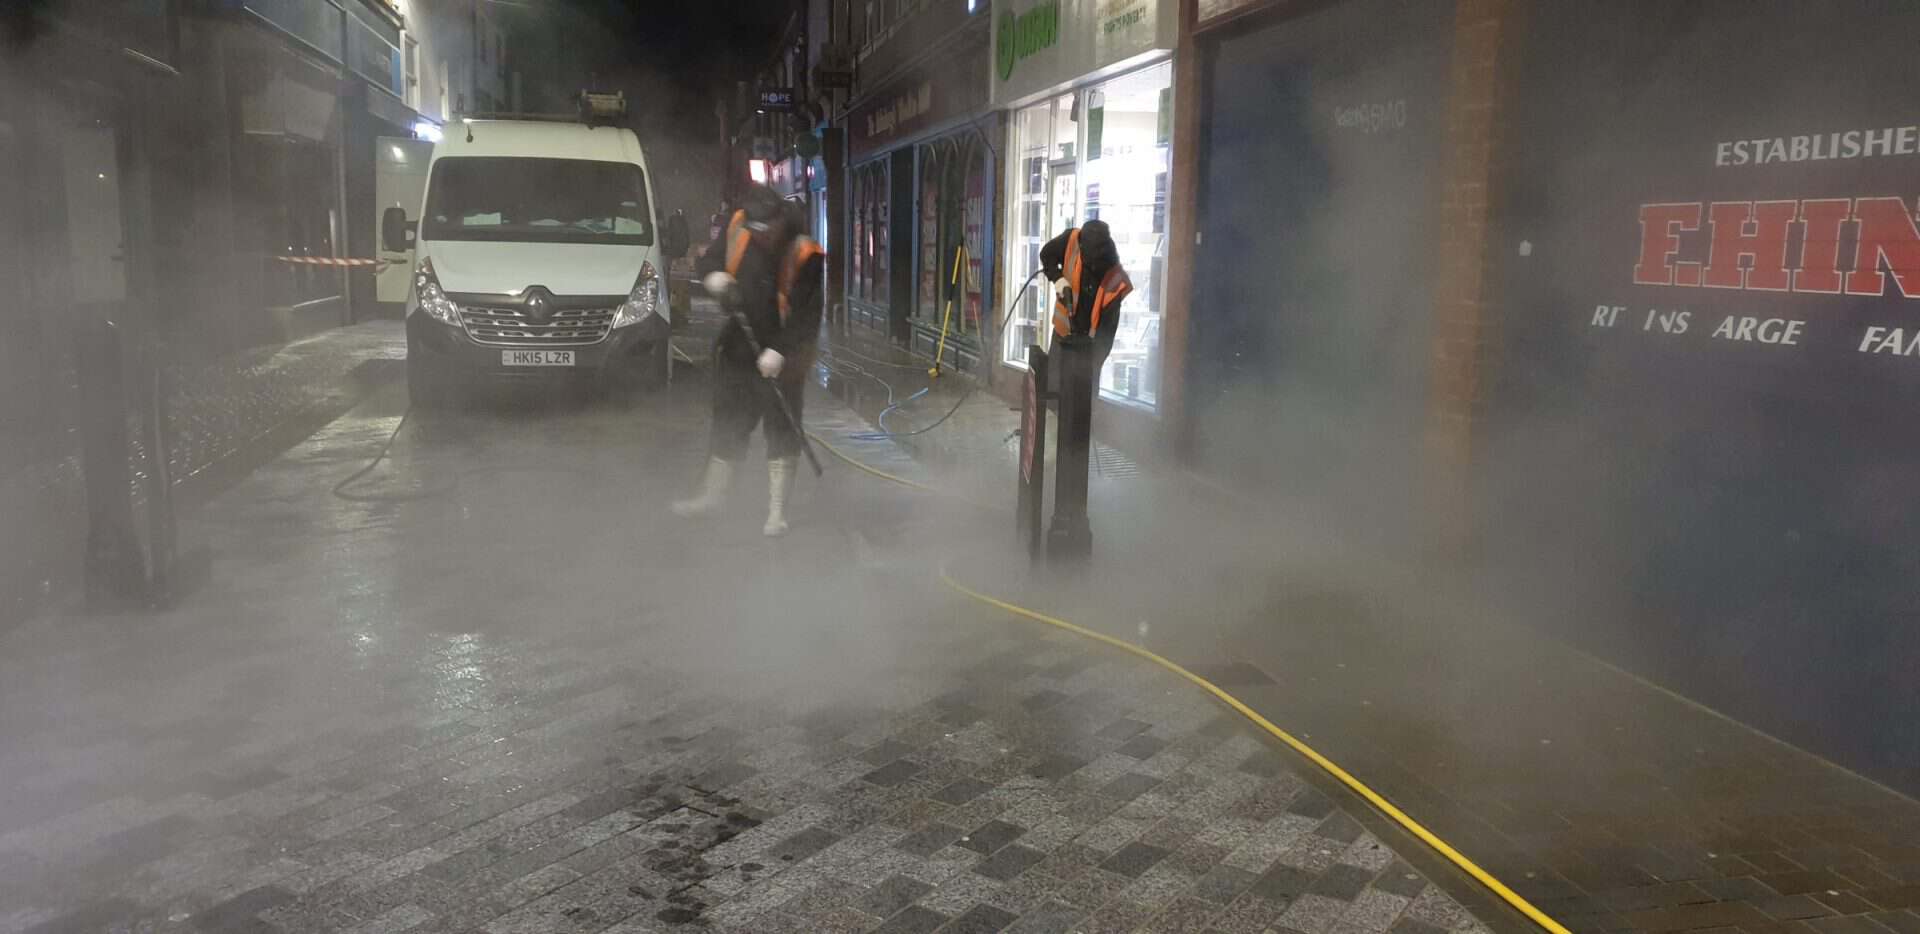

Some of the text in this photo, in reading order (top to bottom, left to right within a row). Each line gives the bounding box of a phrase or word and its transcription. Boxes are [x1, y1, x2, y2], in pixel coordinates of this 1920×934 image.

[1715, 126, 1920, 166] ESTABLISHE
[513, 352, 570, 364] HK15 LZR
